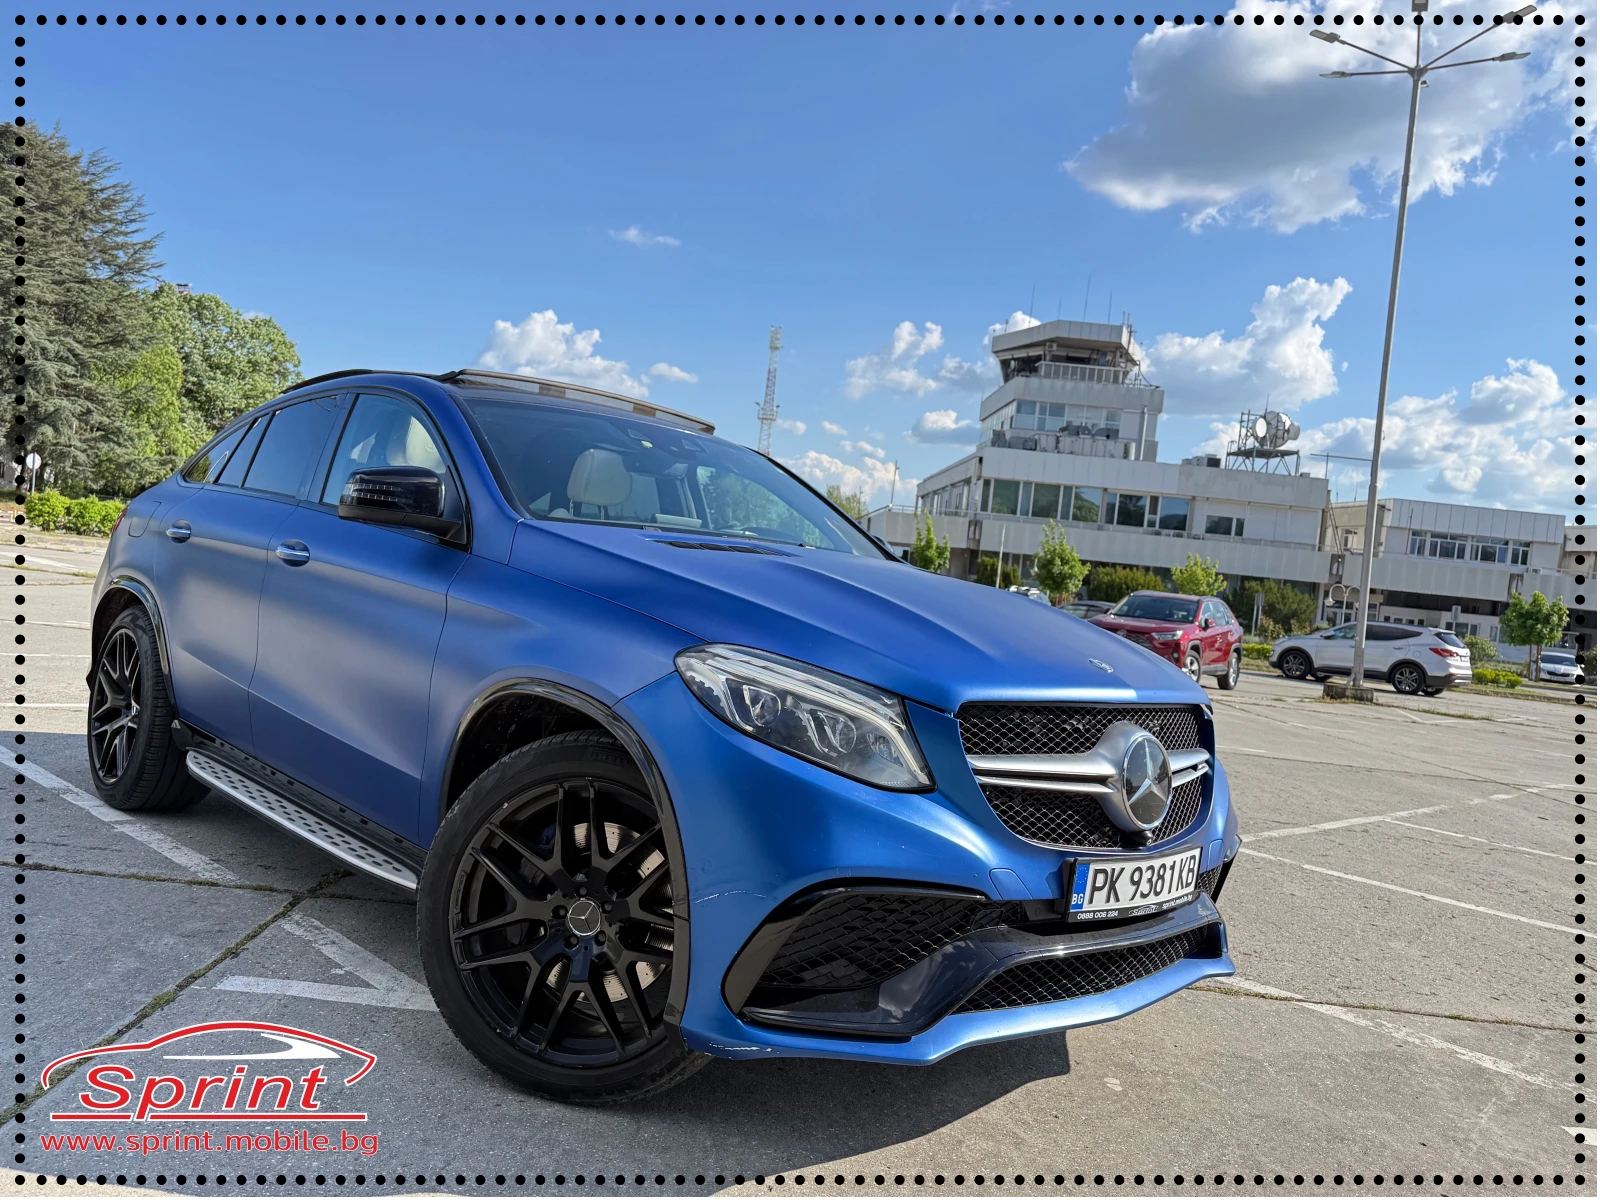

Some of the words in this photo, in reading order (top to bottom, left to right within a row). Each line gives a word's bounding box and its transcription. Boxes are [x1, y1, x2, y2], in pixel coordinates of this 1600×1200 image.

[1088, 867, 1126, 905] PK
[1129, 860, 1176, 902] 9381
[1071, 893, 1084, 905] BG
